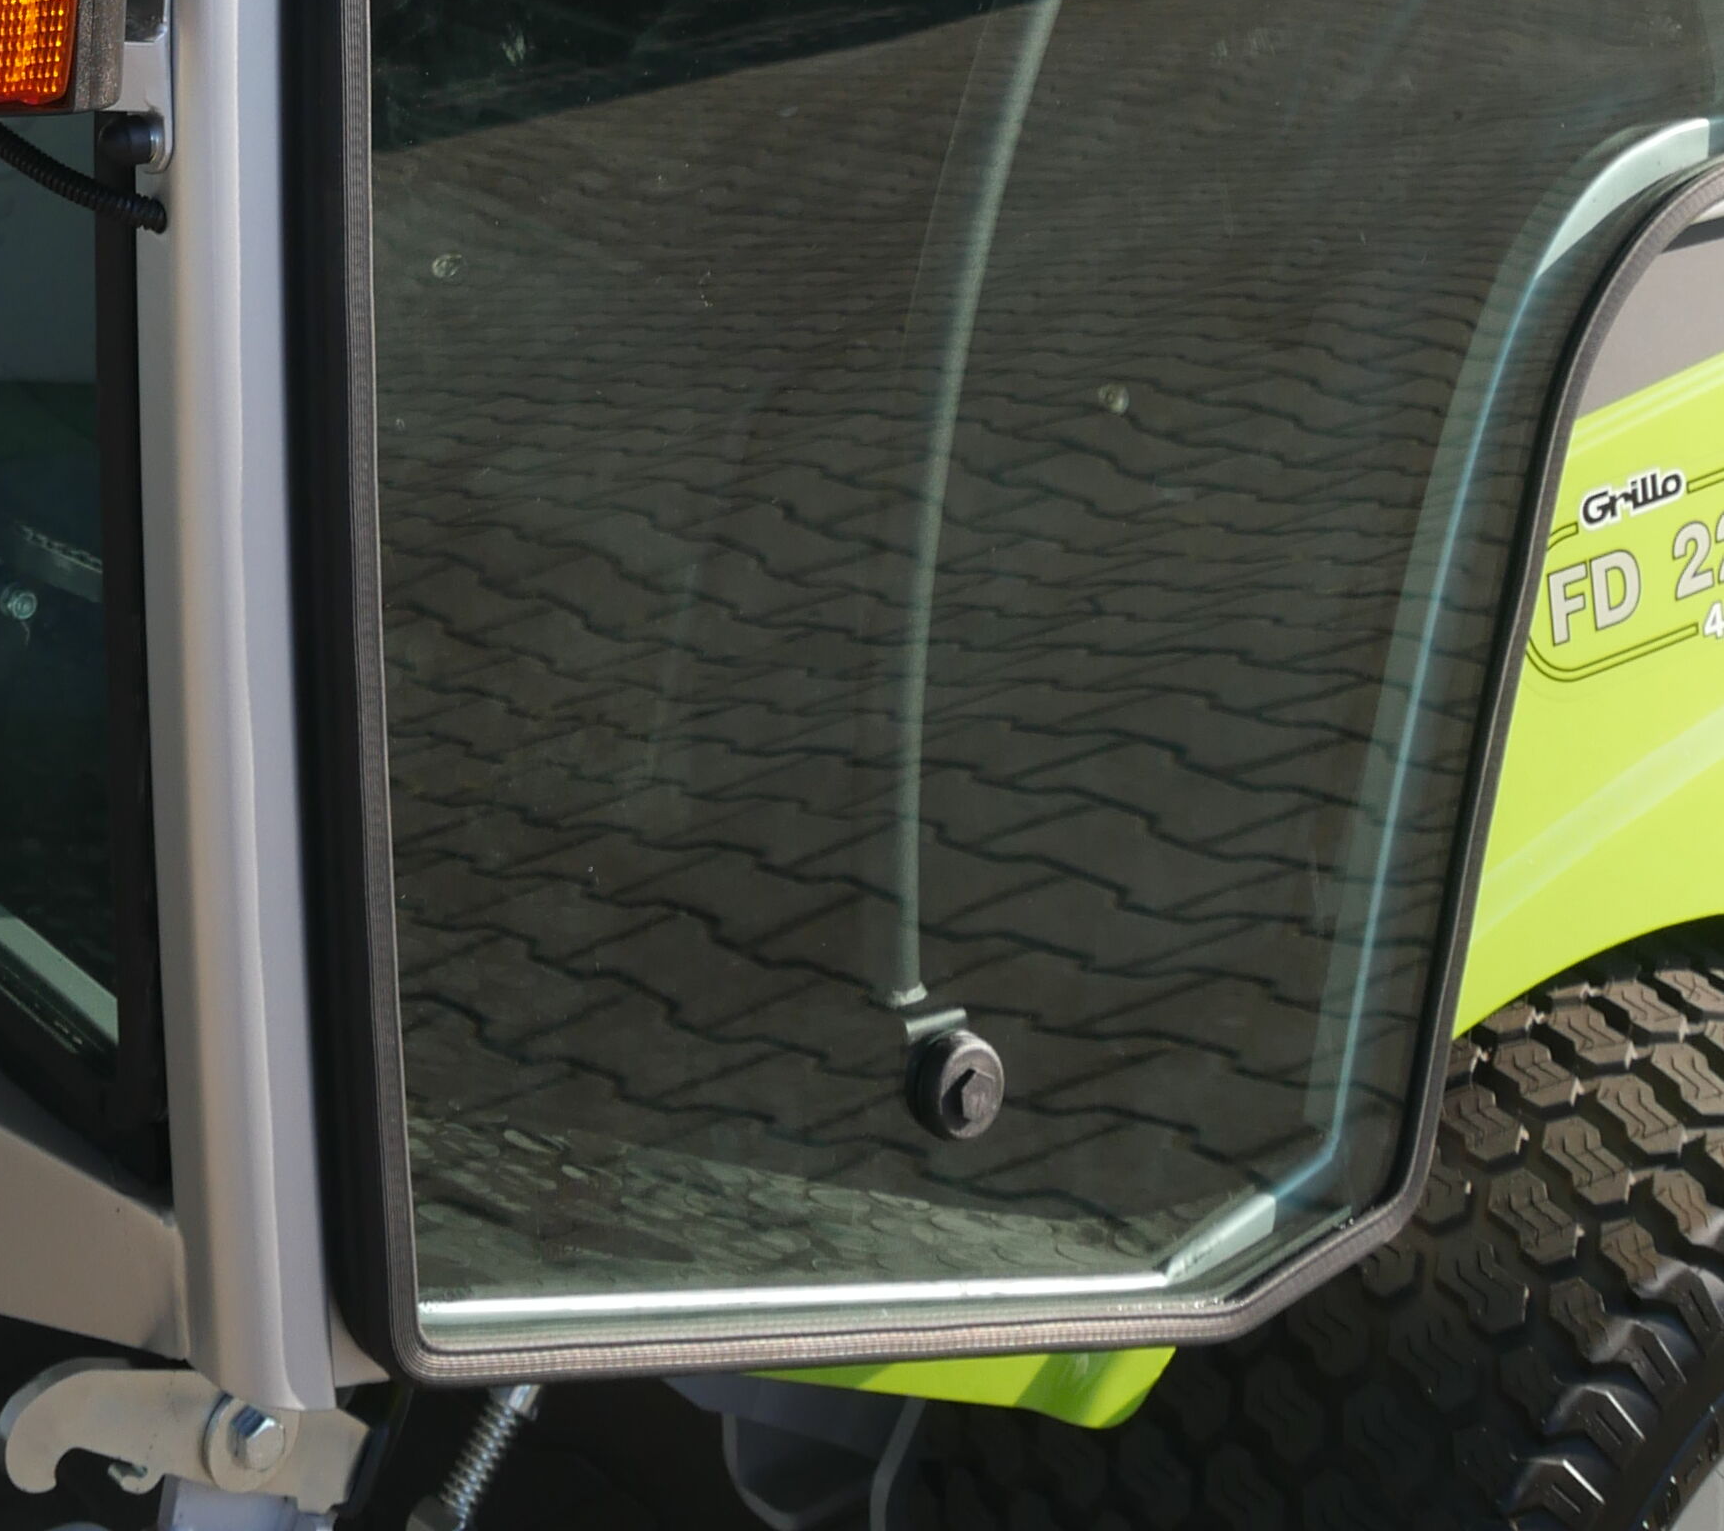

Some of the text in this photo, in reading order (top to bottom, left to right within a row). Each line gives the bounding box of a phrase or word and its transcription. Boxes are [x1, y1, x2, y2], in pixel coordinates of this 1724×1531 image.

[1582, 472, 1682, 525] Grillo
[1547, 512, 1724, 647] FD 2
